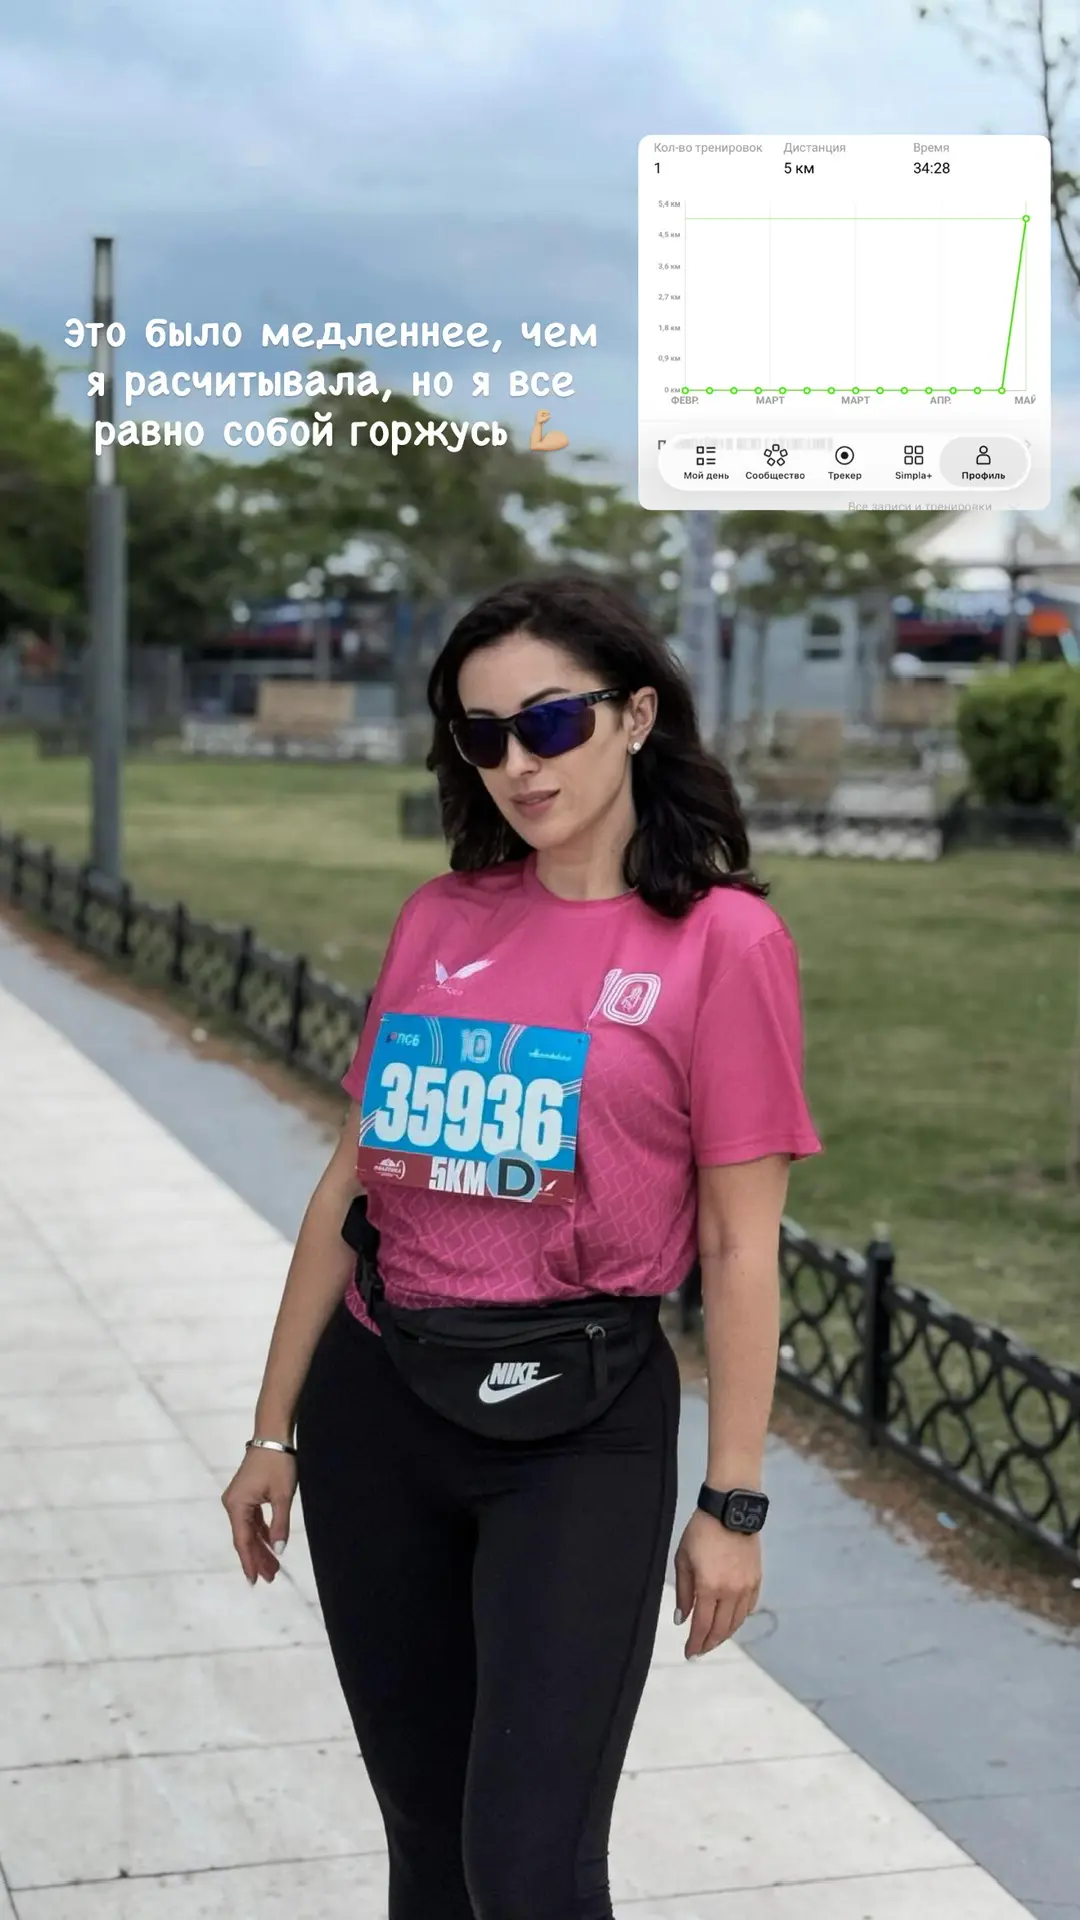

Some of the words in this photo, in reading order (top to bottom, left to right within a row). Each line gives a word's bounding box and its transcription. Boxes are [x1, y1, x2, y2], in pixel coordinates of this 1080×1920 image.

[374, 1062, 564, 1161] 35936
[428, 1155, 487, 1196] 5KM
[497, 1158, 535, 1196] D
[489, 1362, 541, 1385] NIKE
